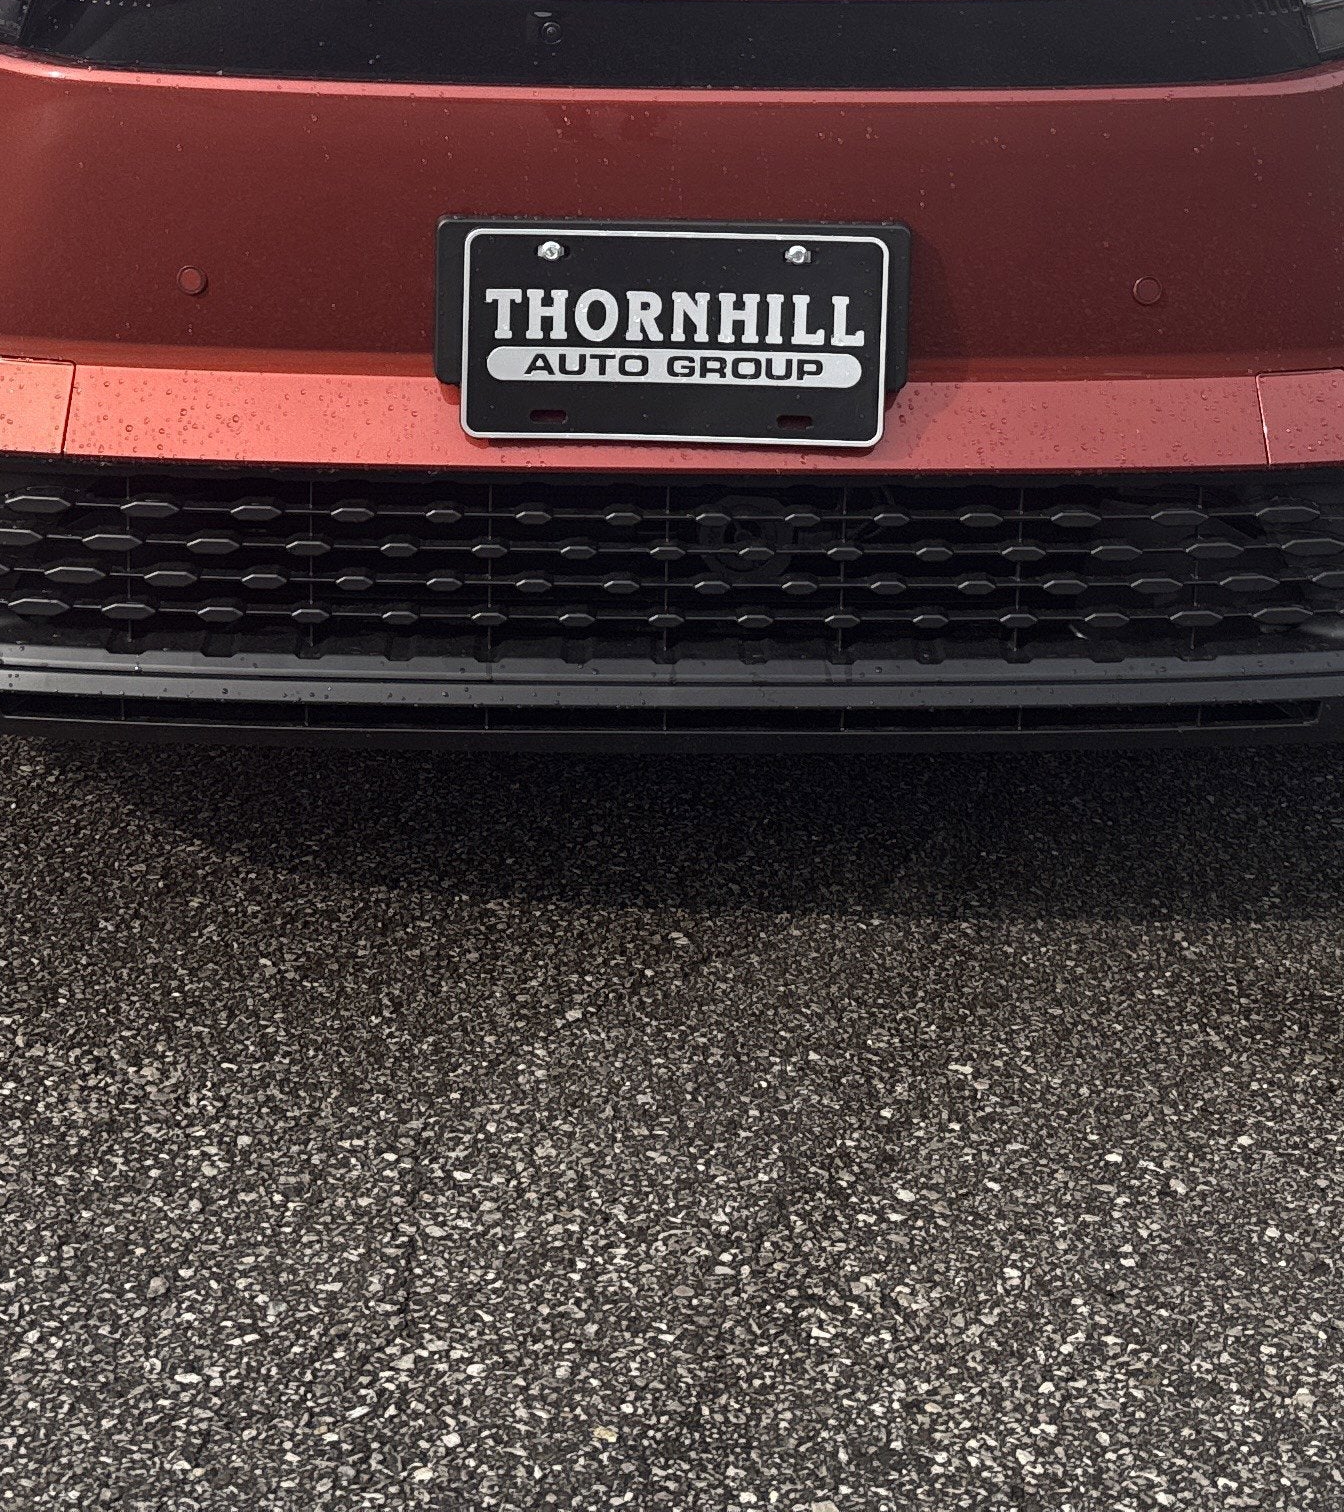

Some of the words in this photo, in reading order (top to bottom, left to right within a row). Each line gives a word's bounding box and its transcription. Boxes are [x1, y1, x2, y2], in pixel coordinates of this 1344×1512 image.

[485, 288, 865, 347] THORNHILL
[524, 352, 649, 377] AUTO
[666, 354, 824, 381] GROUP
